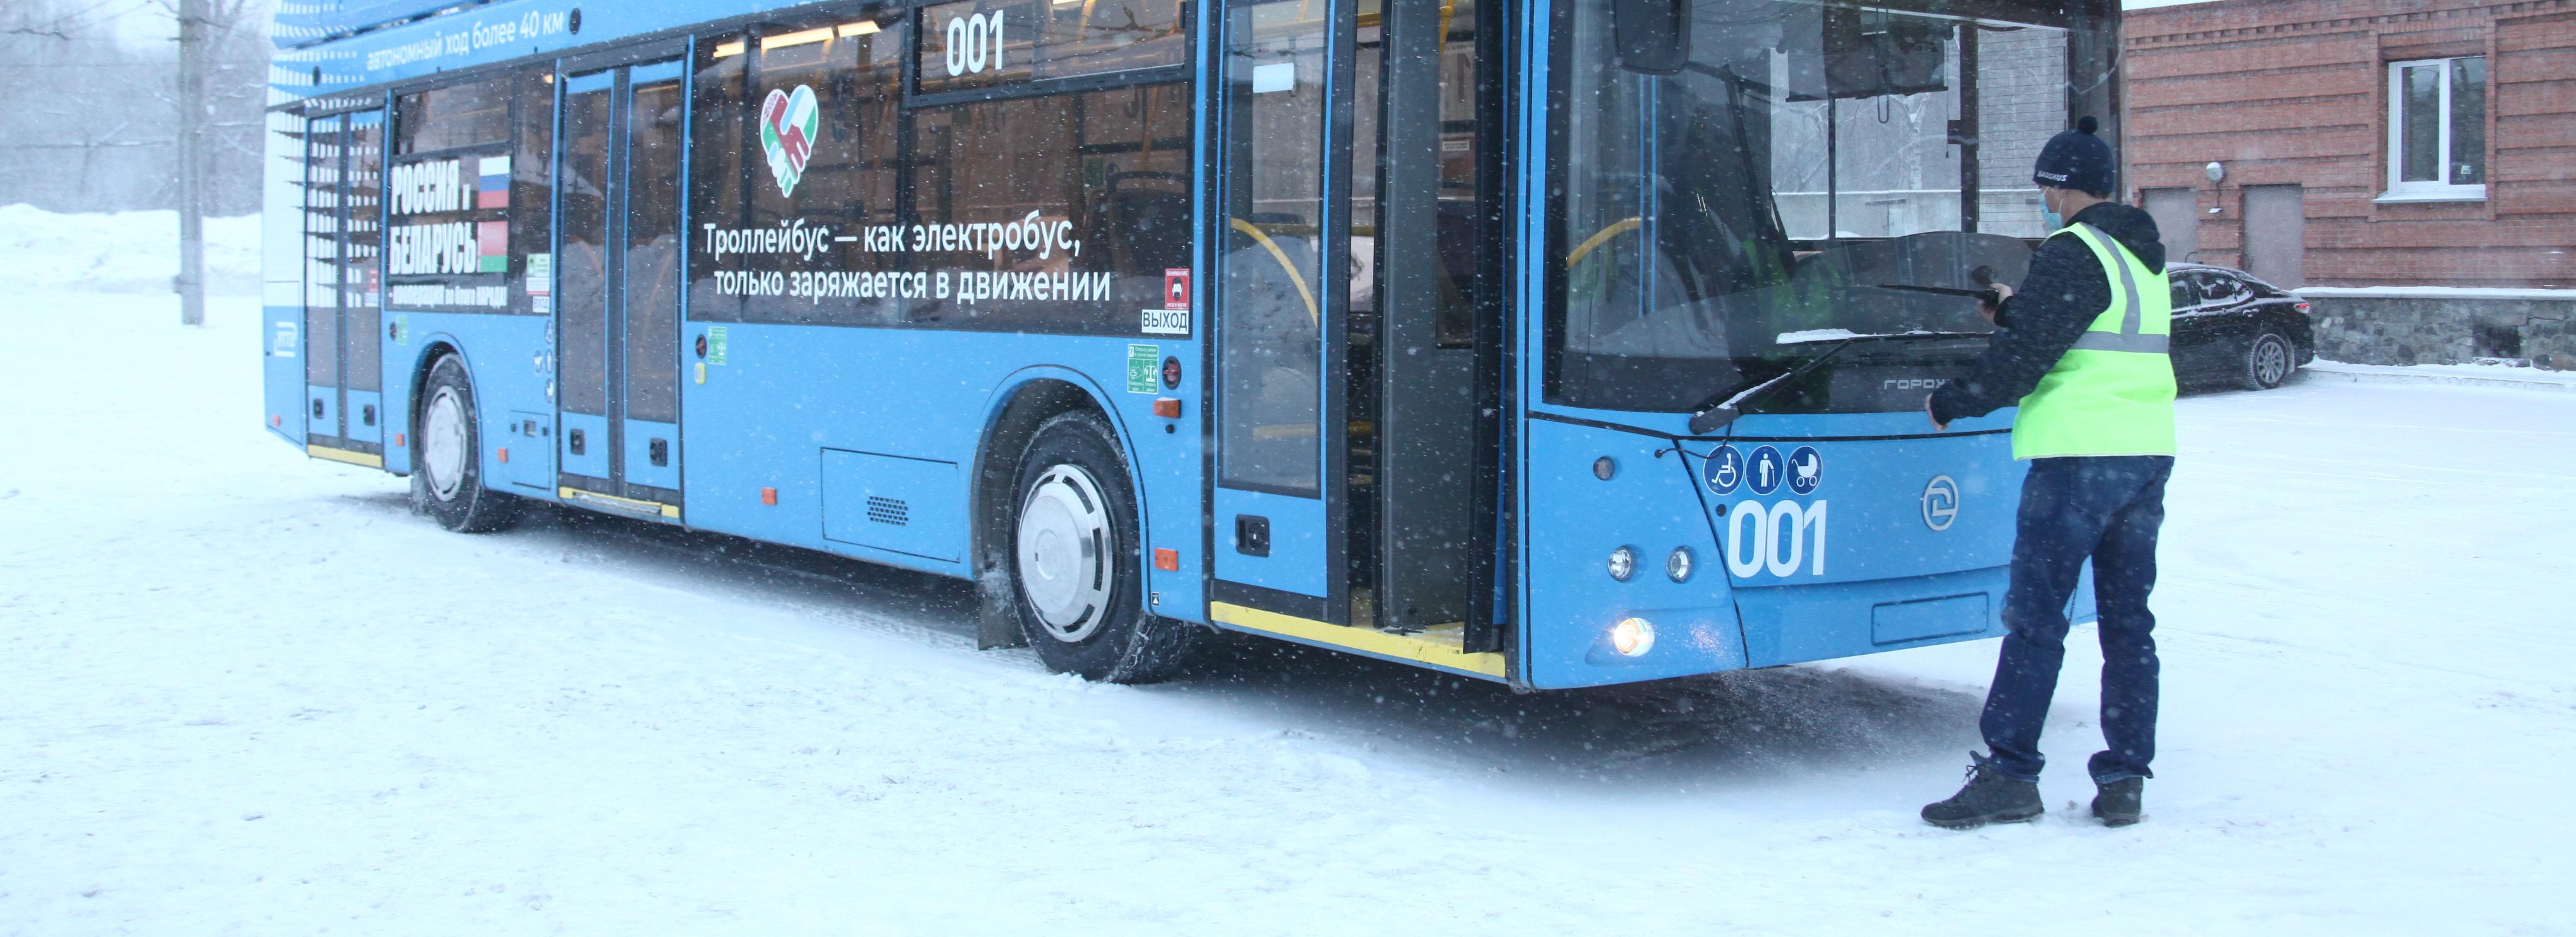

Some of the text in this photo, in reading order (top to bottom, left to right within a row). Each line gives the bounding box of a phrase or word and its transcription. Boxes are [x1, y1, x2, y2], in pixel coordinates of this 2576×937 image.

[366, 11, 564, 71] автономный ход более 40 км
[947, 9, 1003, 76] 001
[391, 159, 460, 215] РОССИЯ
[389, 222, 477, 275] БЕЛАРУСЬ
[703, 218, 829, 261] Троллейбус
[864, 225, 905, 252] как
[912, 209, 1080, 260] электробус,
[713, 270, 1110, 305] только заряжается в движении
[1143, 312, 1188, 331] ВЫХОД
[1884, 379, 1950, 390] ГОРОЖ
[1727, 499, 1827, 578] 001
